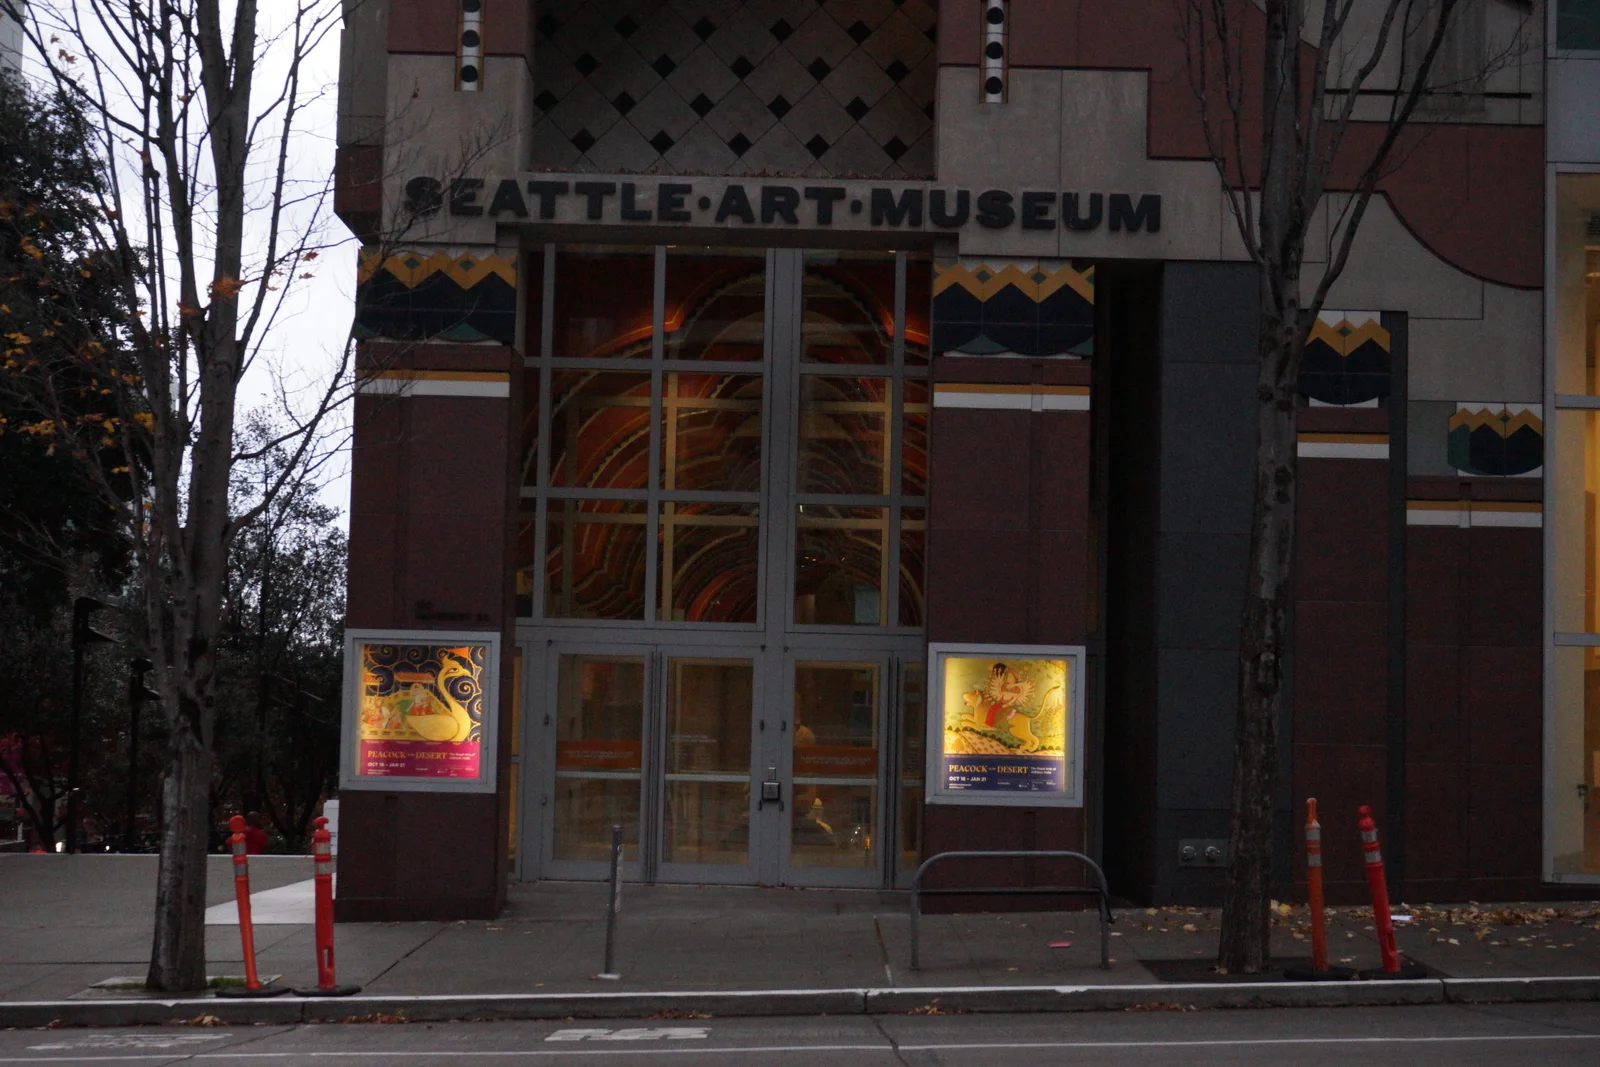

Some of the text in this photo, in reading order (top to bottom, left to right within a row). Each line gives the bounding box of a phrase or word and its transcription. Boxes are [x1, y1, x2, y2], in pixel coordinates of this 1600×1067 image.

[404, 176, 1162, 234] SEATTLE ART MUSEUM
[367, 750, 406, 759] PEACOCK
[415, 751, 447, 760] DESERT
[948, 765, 987, 773] PEACOCK
[997, 766, 1029, 774] DESERT
